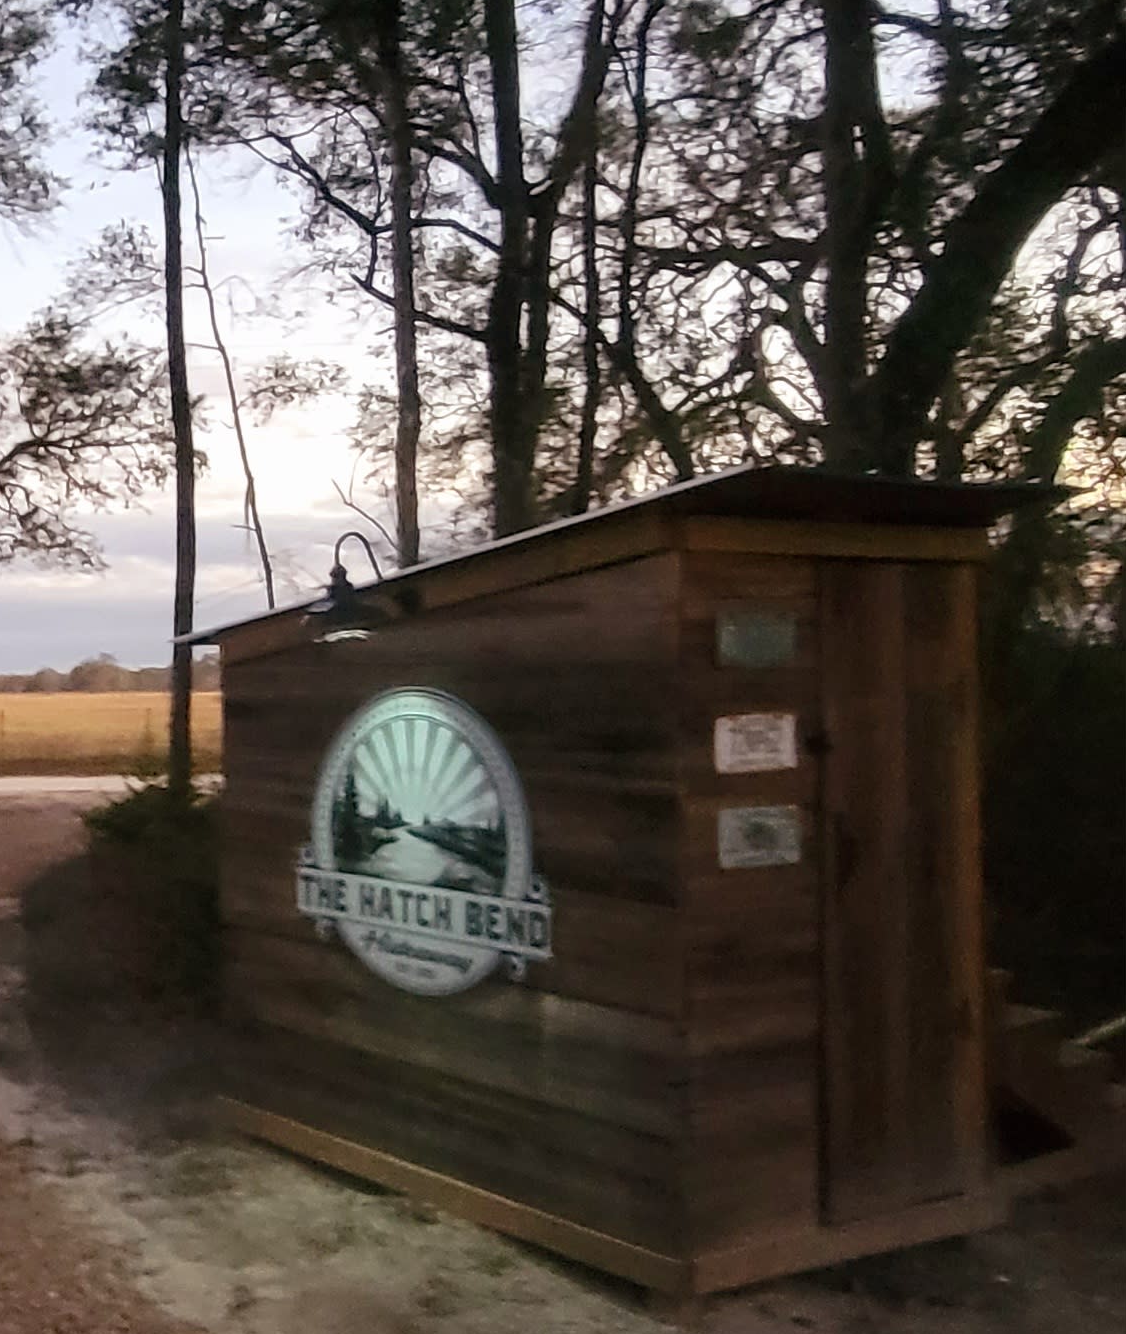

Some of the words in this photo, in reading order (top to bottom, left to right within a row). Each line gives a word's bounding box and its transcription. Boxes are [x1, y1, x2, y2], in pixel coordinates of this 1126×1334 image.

[299, 873, 348, 913] THE
[359, 881, 453, 932] HATCH
[464, 899, 549, 948] BEND
